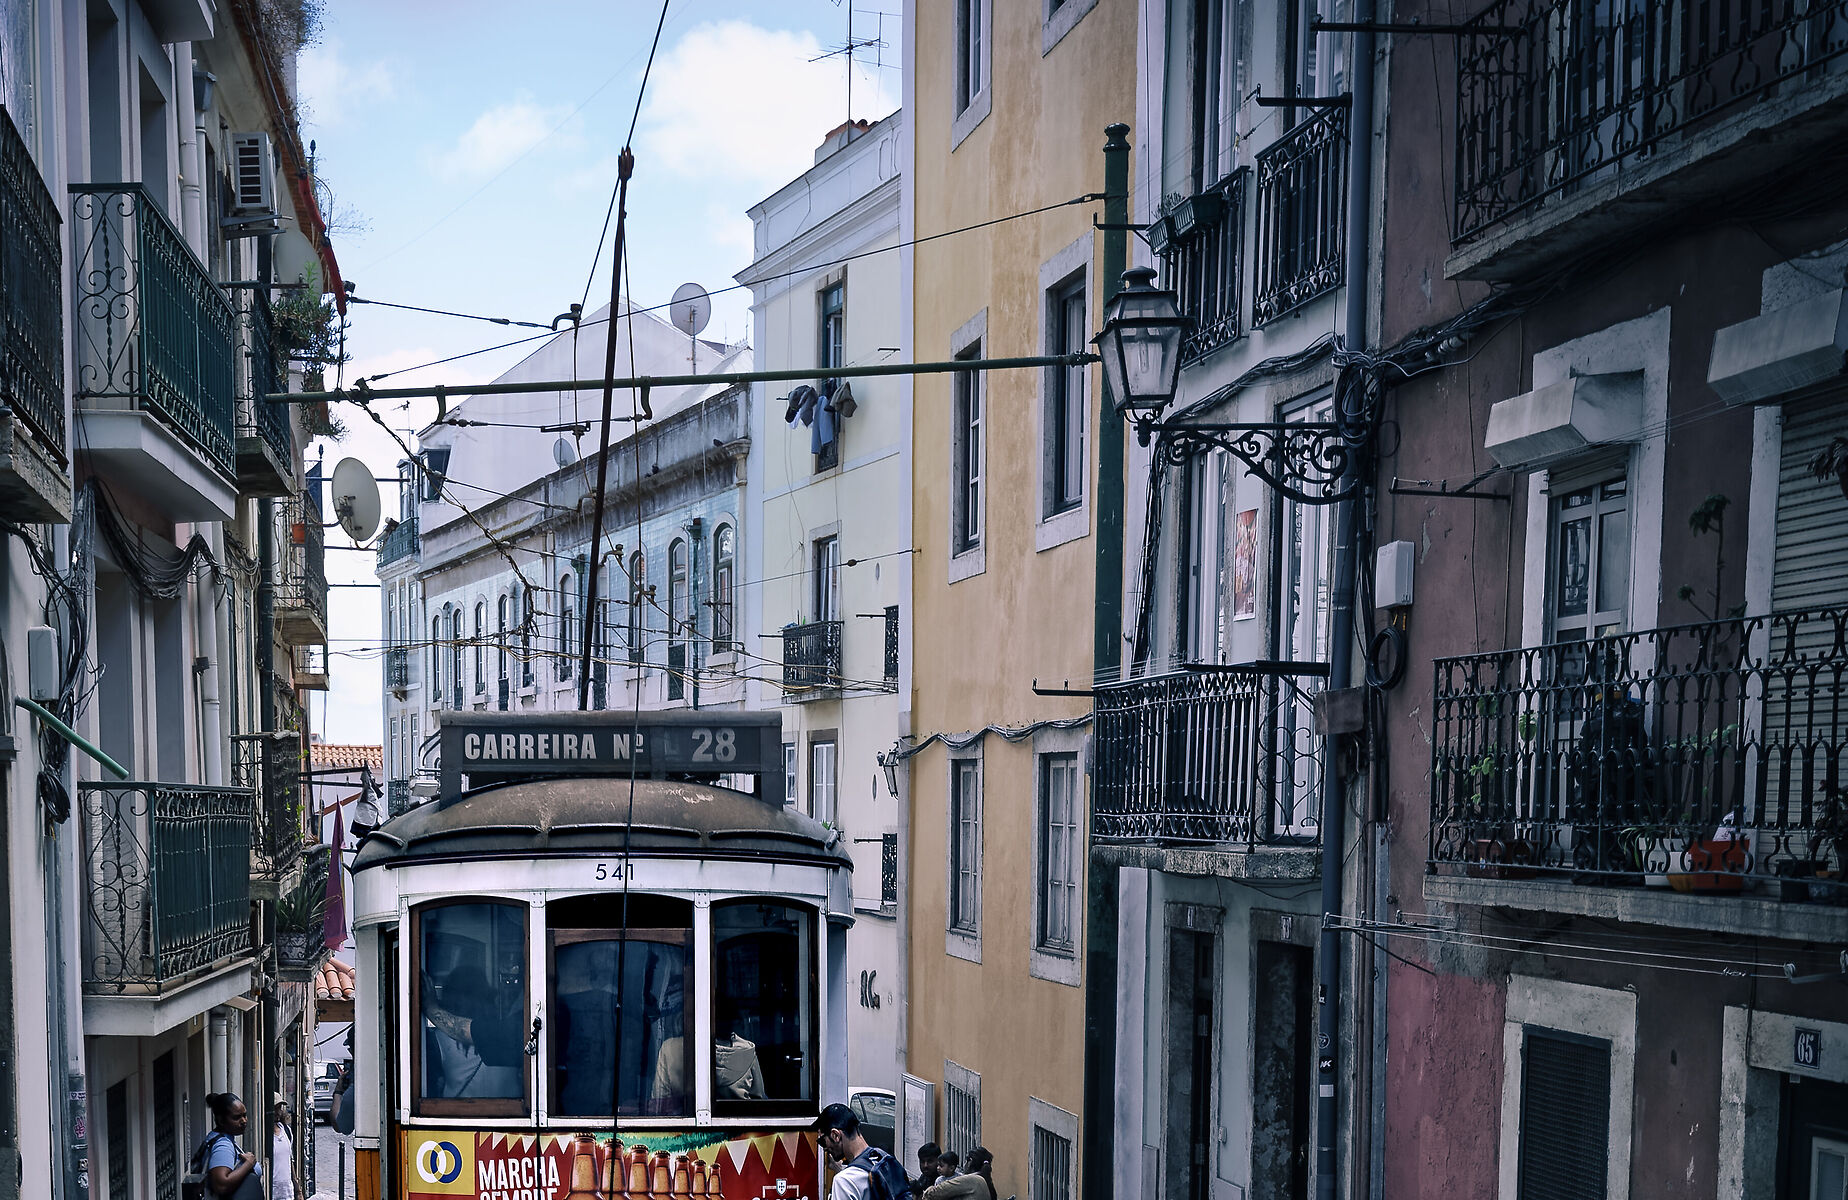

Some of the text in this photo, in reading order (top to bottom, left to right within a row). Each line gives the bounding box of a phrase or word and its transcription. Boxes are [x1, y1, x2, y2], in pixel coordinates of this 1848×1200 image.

[464, 733, 597, 760] CARREIRA
[692, 728, 737, 762] 28
[595, 863, 634, 881] 541
[1797, 1033, 1815, 1064] 65
[478, 1156, 560, 1190] MARCHA
